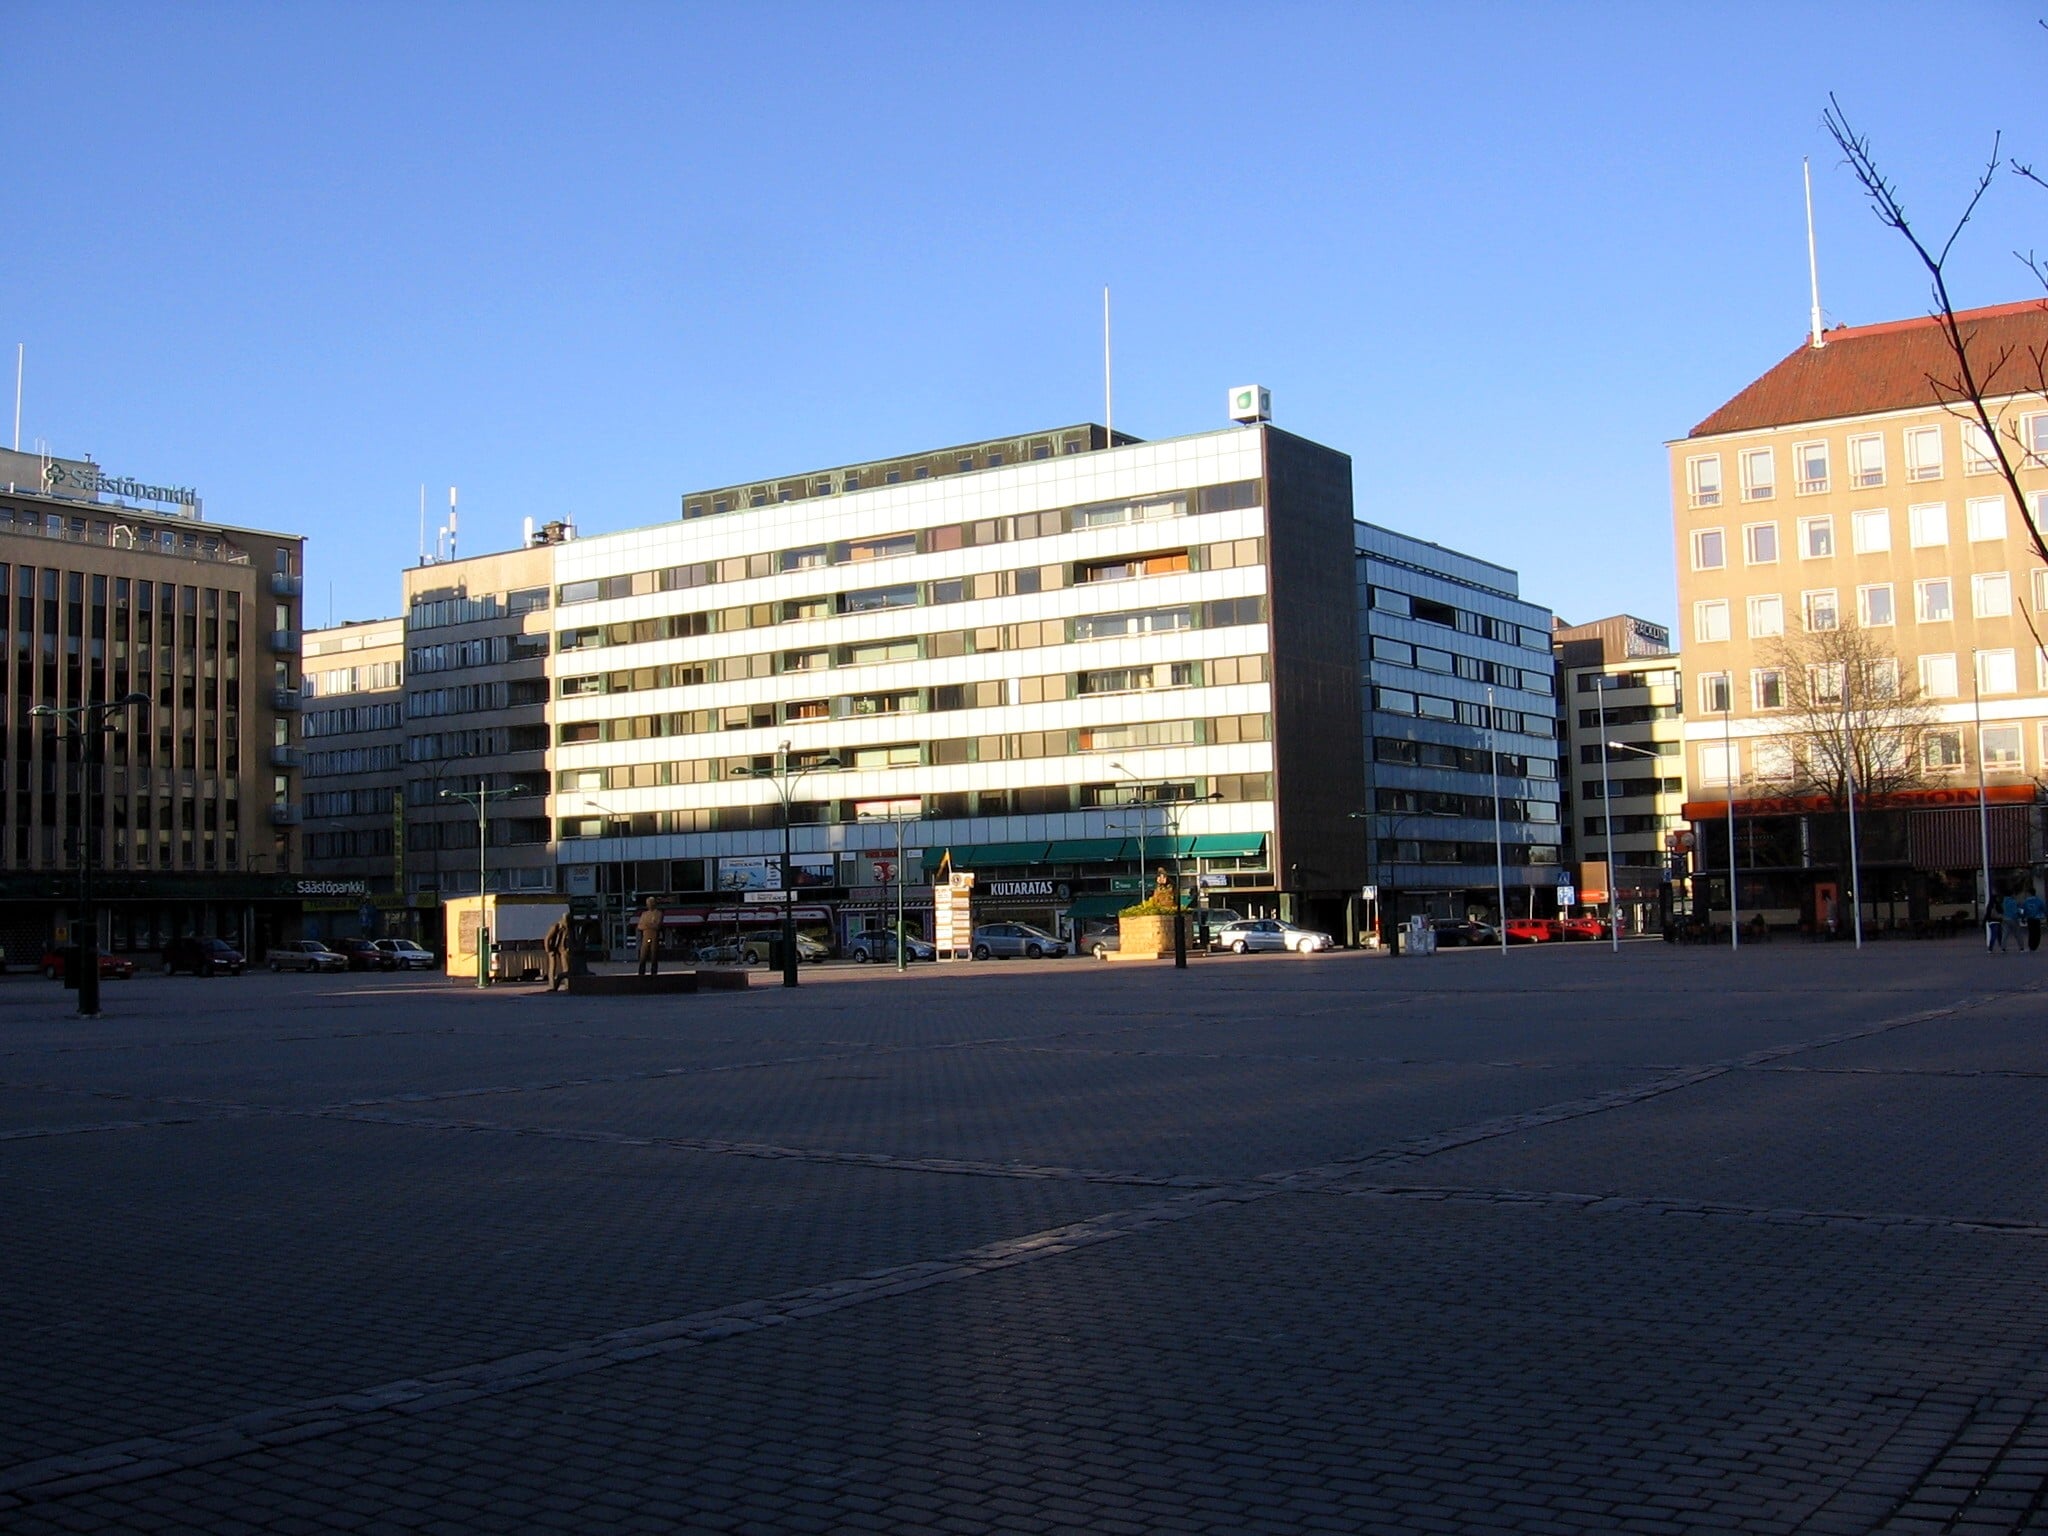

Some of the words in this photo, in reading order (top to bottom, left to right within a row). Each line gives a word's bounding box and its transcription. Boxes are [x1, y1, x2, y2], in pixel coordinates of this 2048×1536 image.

[71, 468, 196, 505] Säästöpankki
[296, 880, 365, 895] Säästöpankki
[990, 880, 1053, 896] KULTARATAS
